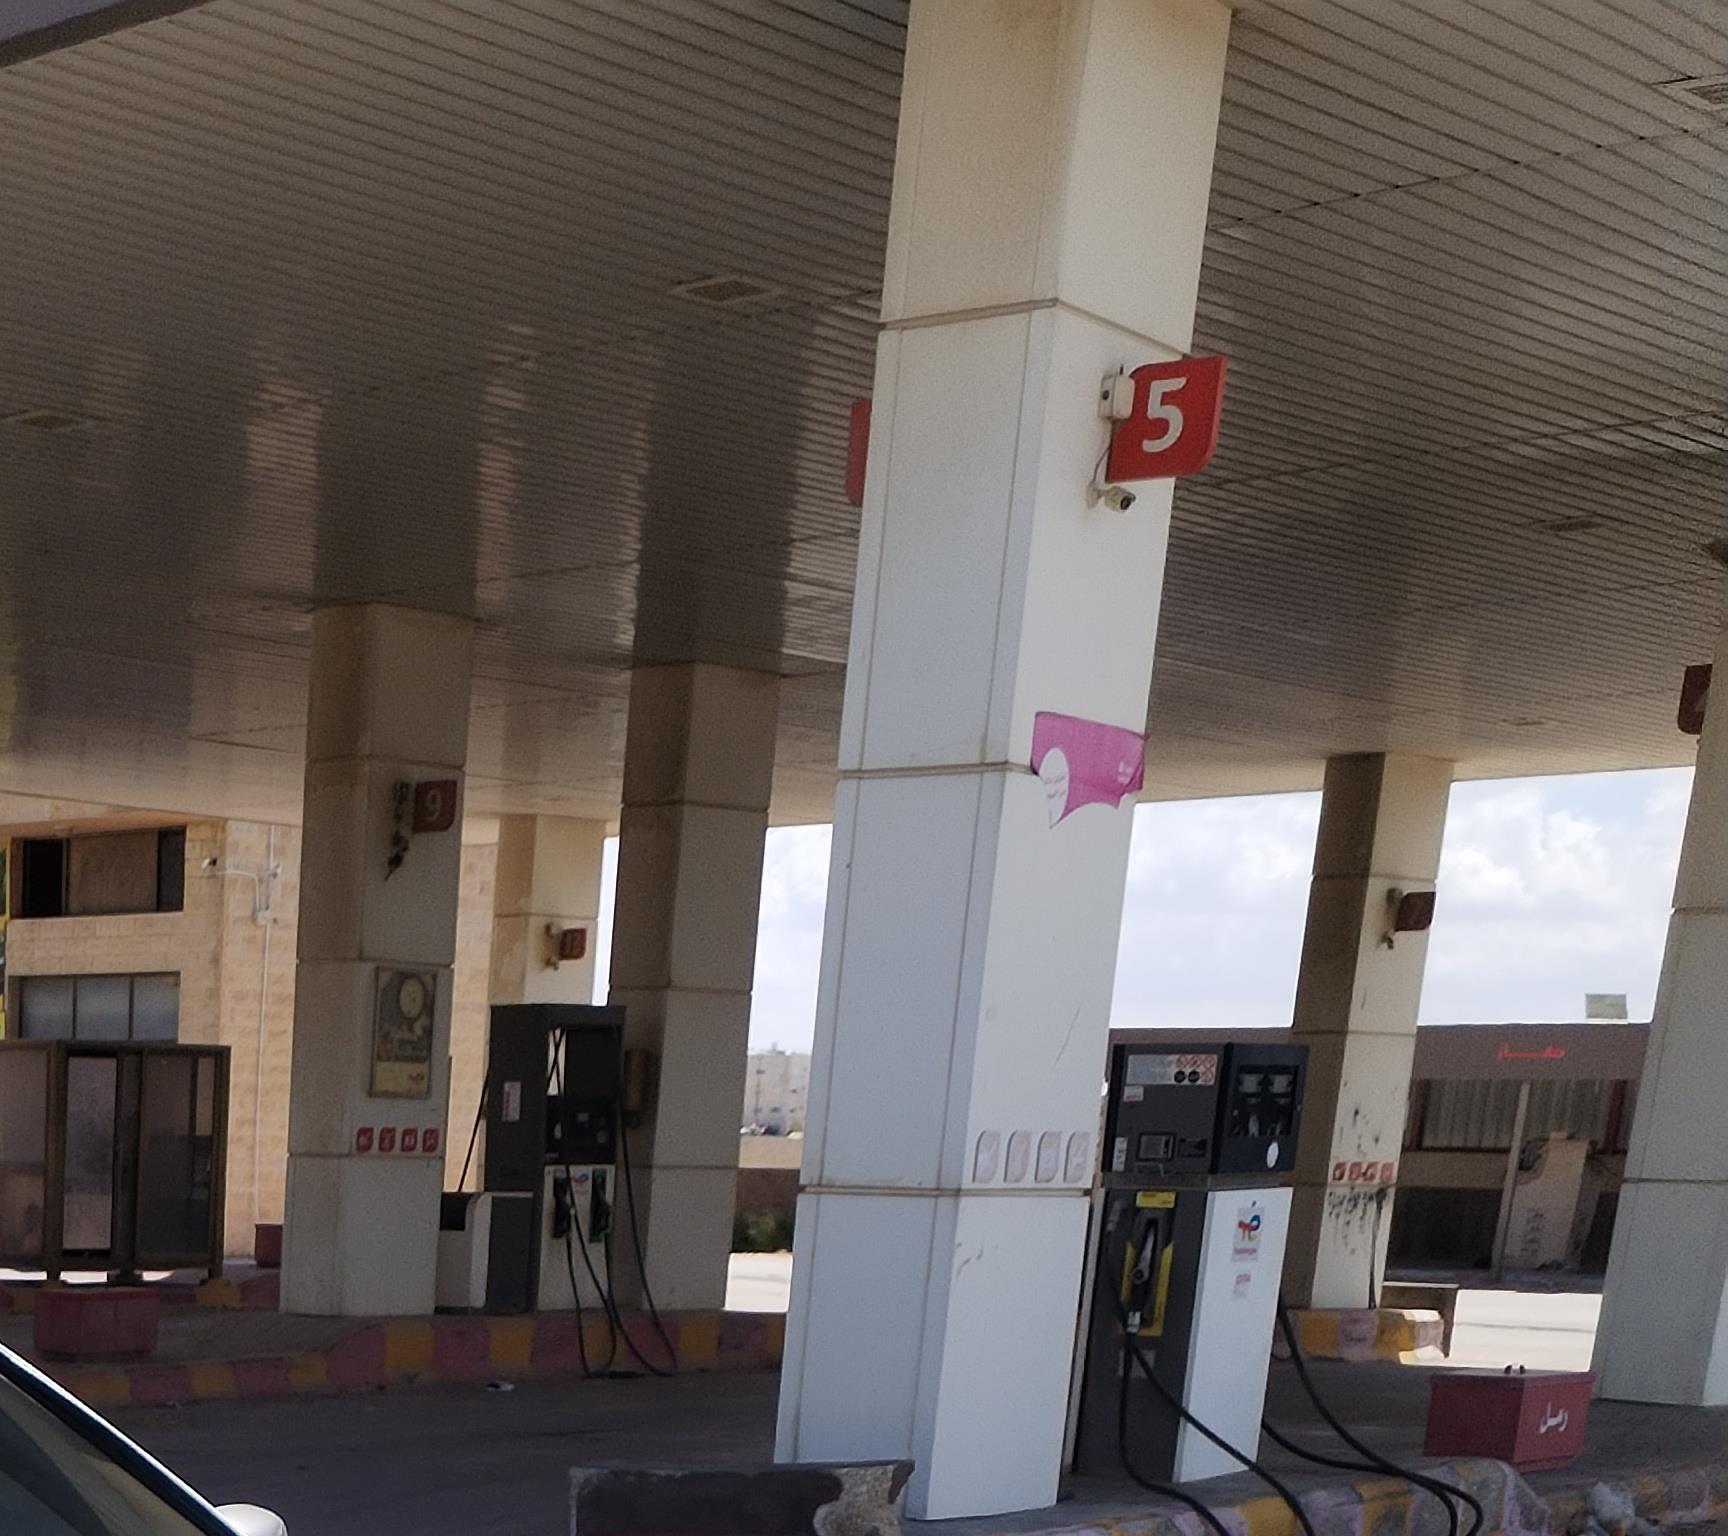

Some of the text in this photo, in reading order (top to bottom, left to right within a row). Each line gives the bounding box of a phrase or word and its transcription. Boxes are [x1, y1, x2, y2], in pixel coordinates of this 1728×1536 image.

[1141, 376, 1188, 453] 5
[423, 789, 443, 823] 9
[1538, 1400, 1569, 1435] رمل
